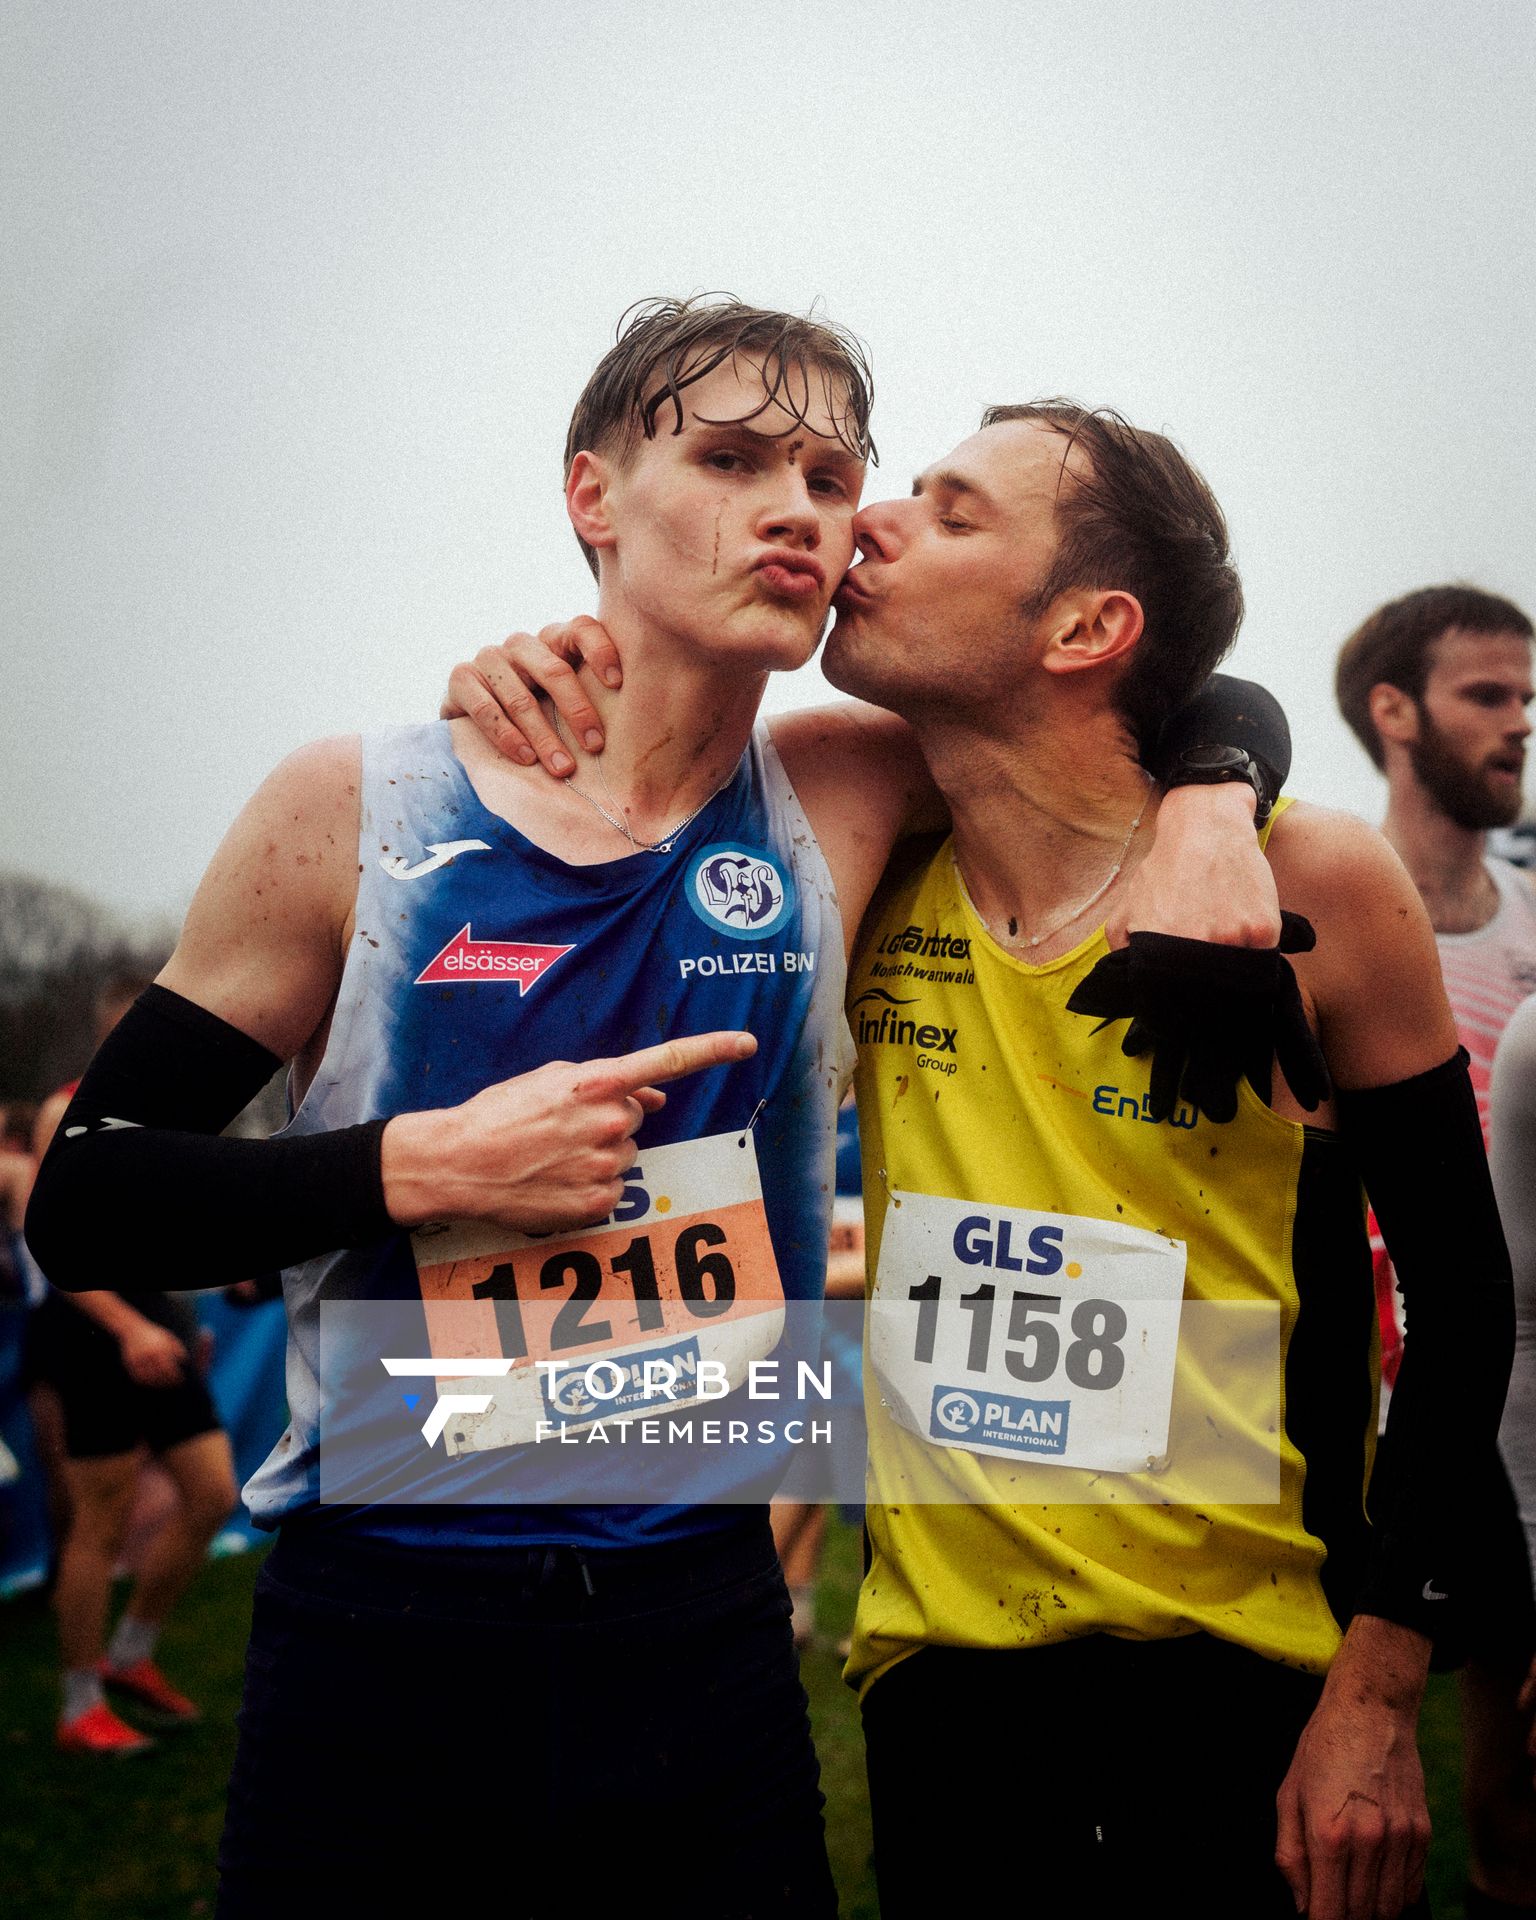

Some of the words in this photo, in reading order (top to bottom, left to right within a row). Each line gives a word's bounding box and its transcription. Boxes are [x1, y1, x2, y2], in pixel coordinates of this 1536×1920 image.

[443, 948, 545, 971] elsässer
[679, 953, 776, 979] POLIZEI
[859, 1007, 958, 1053] infinex
[917, 1054, 957, 1076] Group
[472, 1223, 736, 1358] 1216
[908, 1275, 1128, 1391] 1158
[610, 1351, 697, 1389] PLAN
[984, 1402, 1062, 1435] PLAN
[982, 1429, 1060, 1448] INTERNATIONAL
